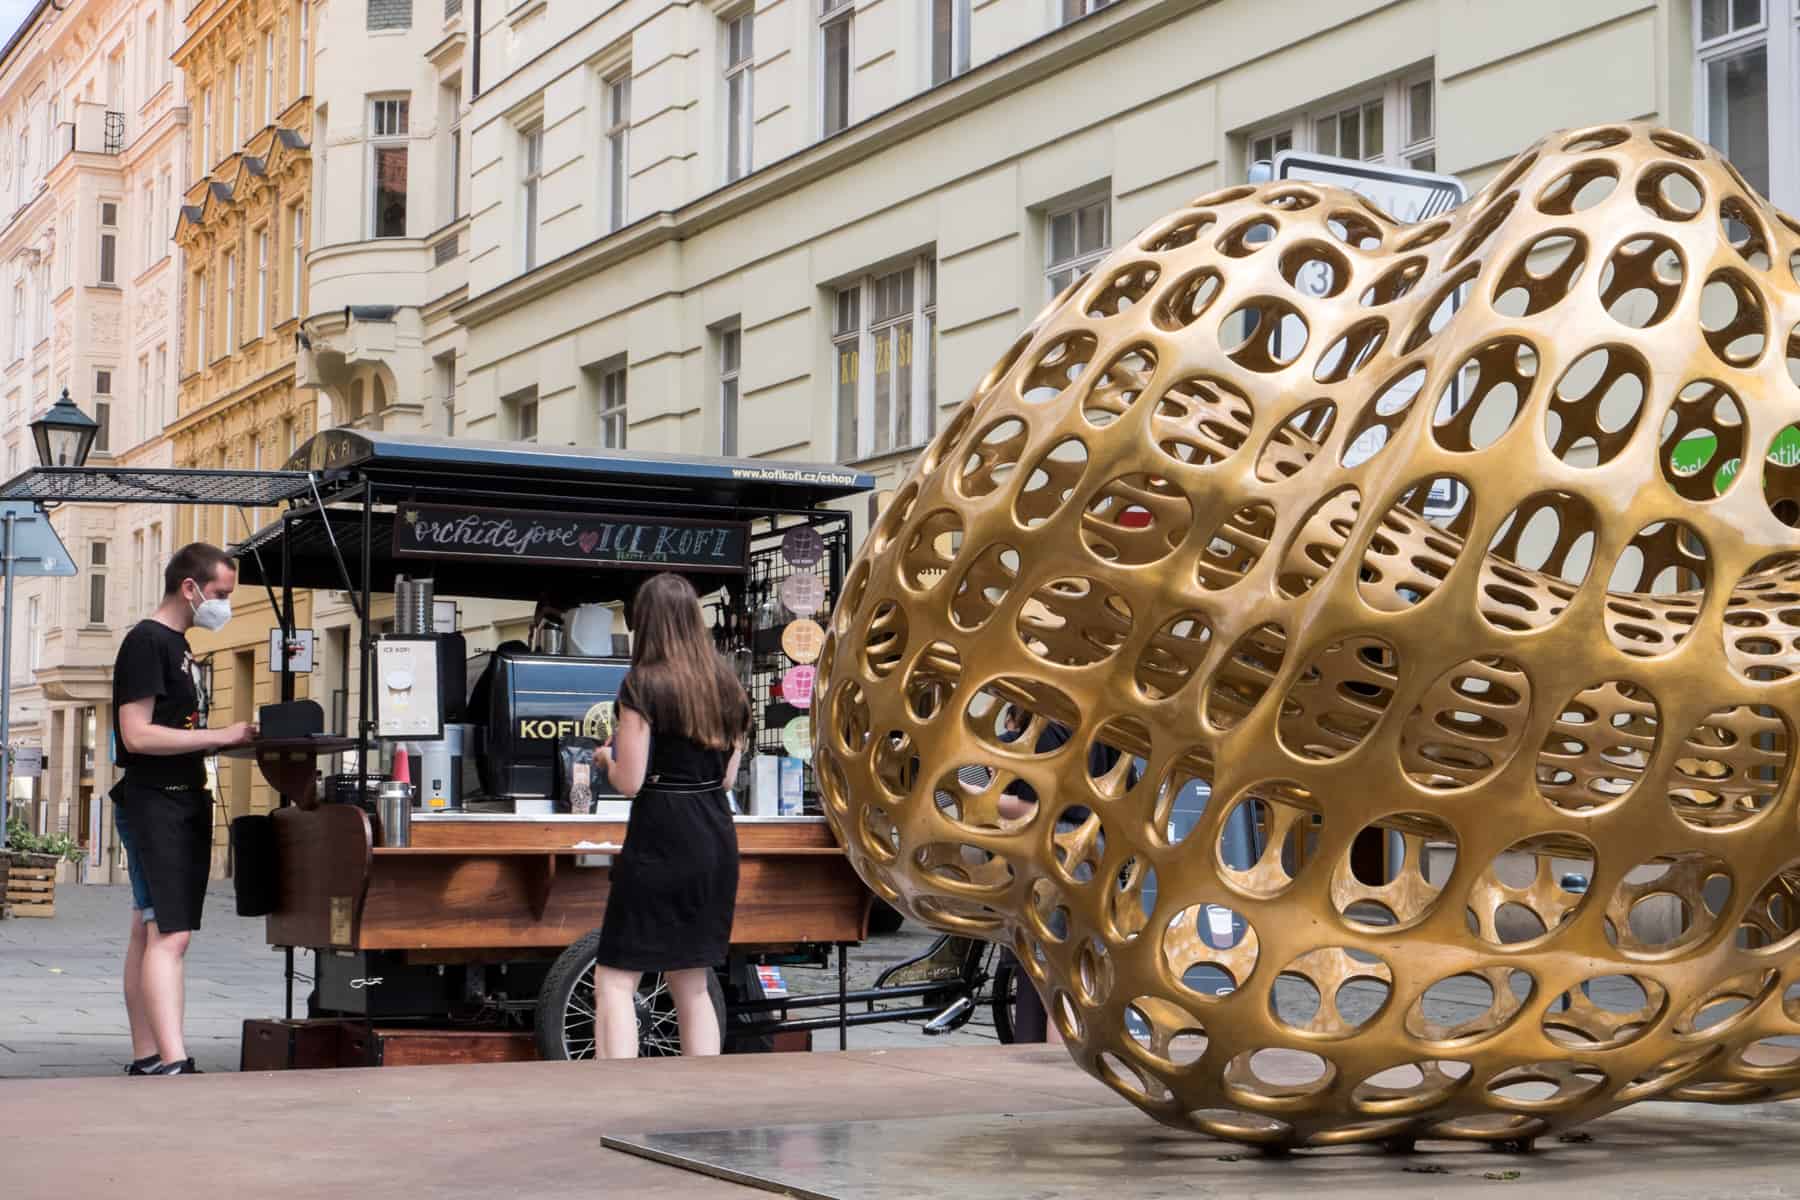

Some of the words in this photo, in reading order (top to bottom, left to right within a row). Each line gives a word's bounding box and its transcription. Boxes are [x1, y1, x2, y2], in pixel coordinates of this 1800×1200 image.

[732, 468, 857, 487] www.kofikofi.cz/eshop/
[596, 523, 652, 554] ICE
[653, 526, 729, 557] KOFI
[520, 720, 580, 739] KOFI
